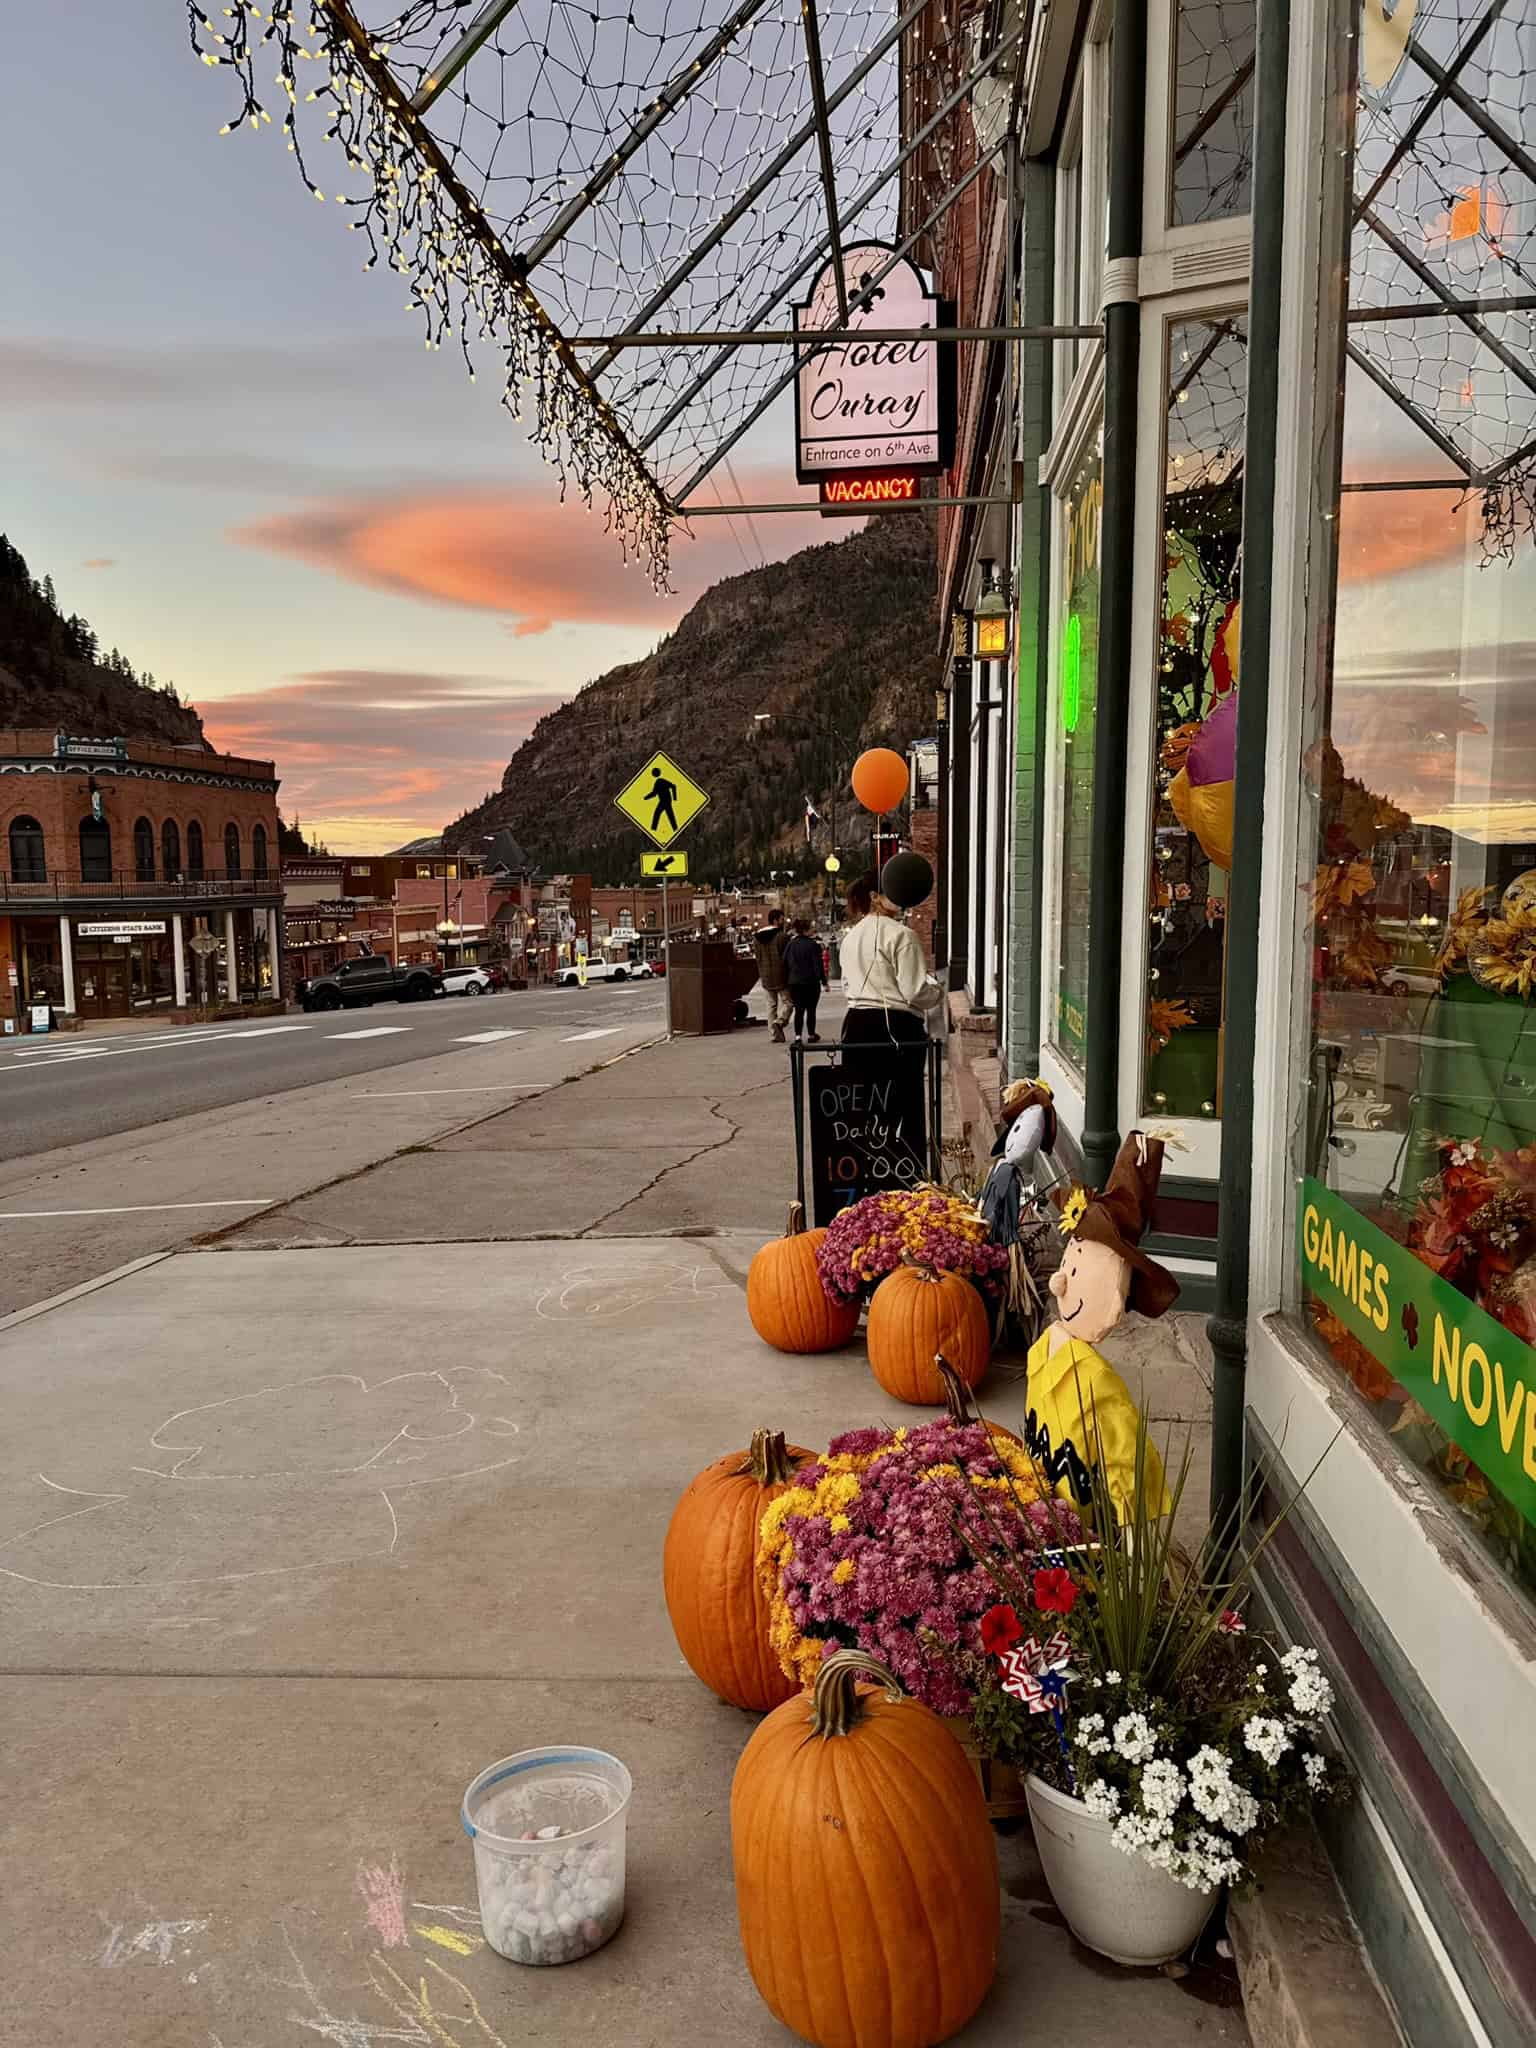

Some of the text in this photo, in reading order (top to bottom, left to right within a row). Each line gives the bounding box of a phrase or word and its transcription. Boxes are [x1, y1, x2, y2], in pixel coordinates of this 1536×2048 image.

[811, 378, 926, 429] Ouray
[806, 440, 934, 462] Entrance on 6th Ave.
[825, 478, 914, 502] VACANCY
[820, 1080, 892, 1117] OPEN
[1303, 1203, 1389, 1332] GAMES
